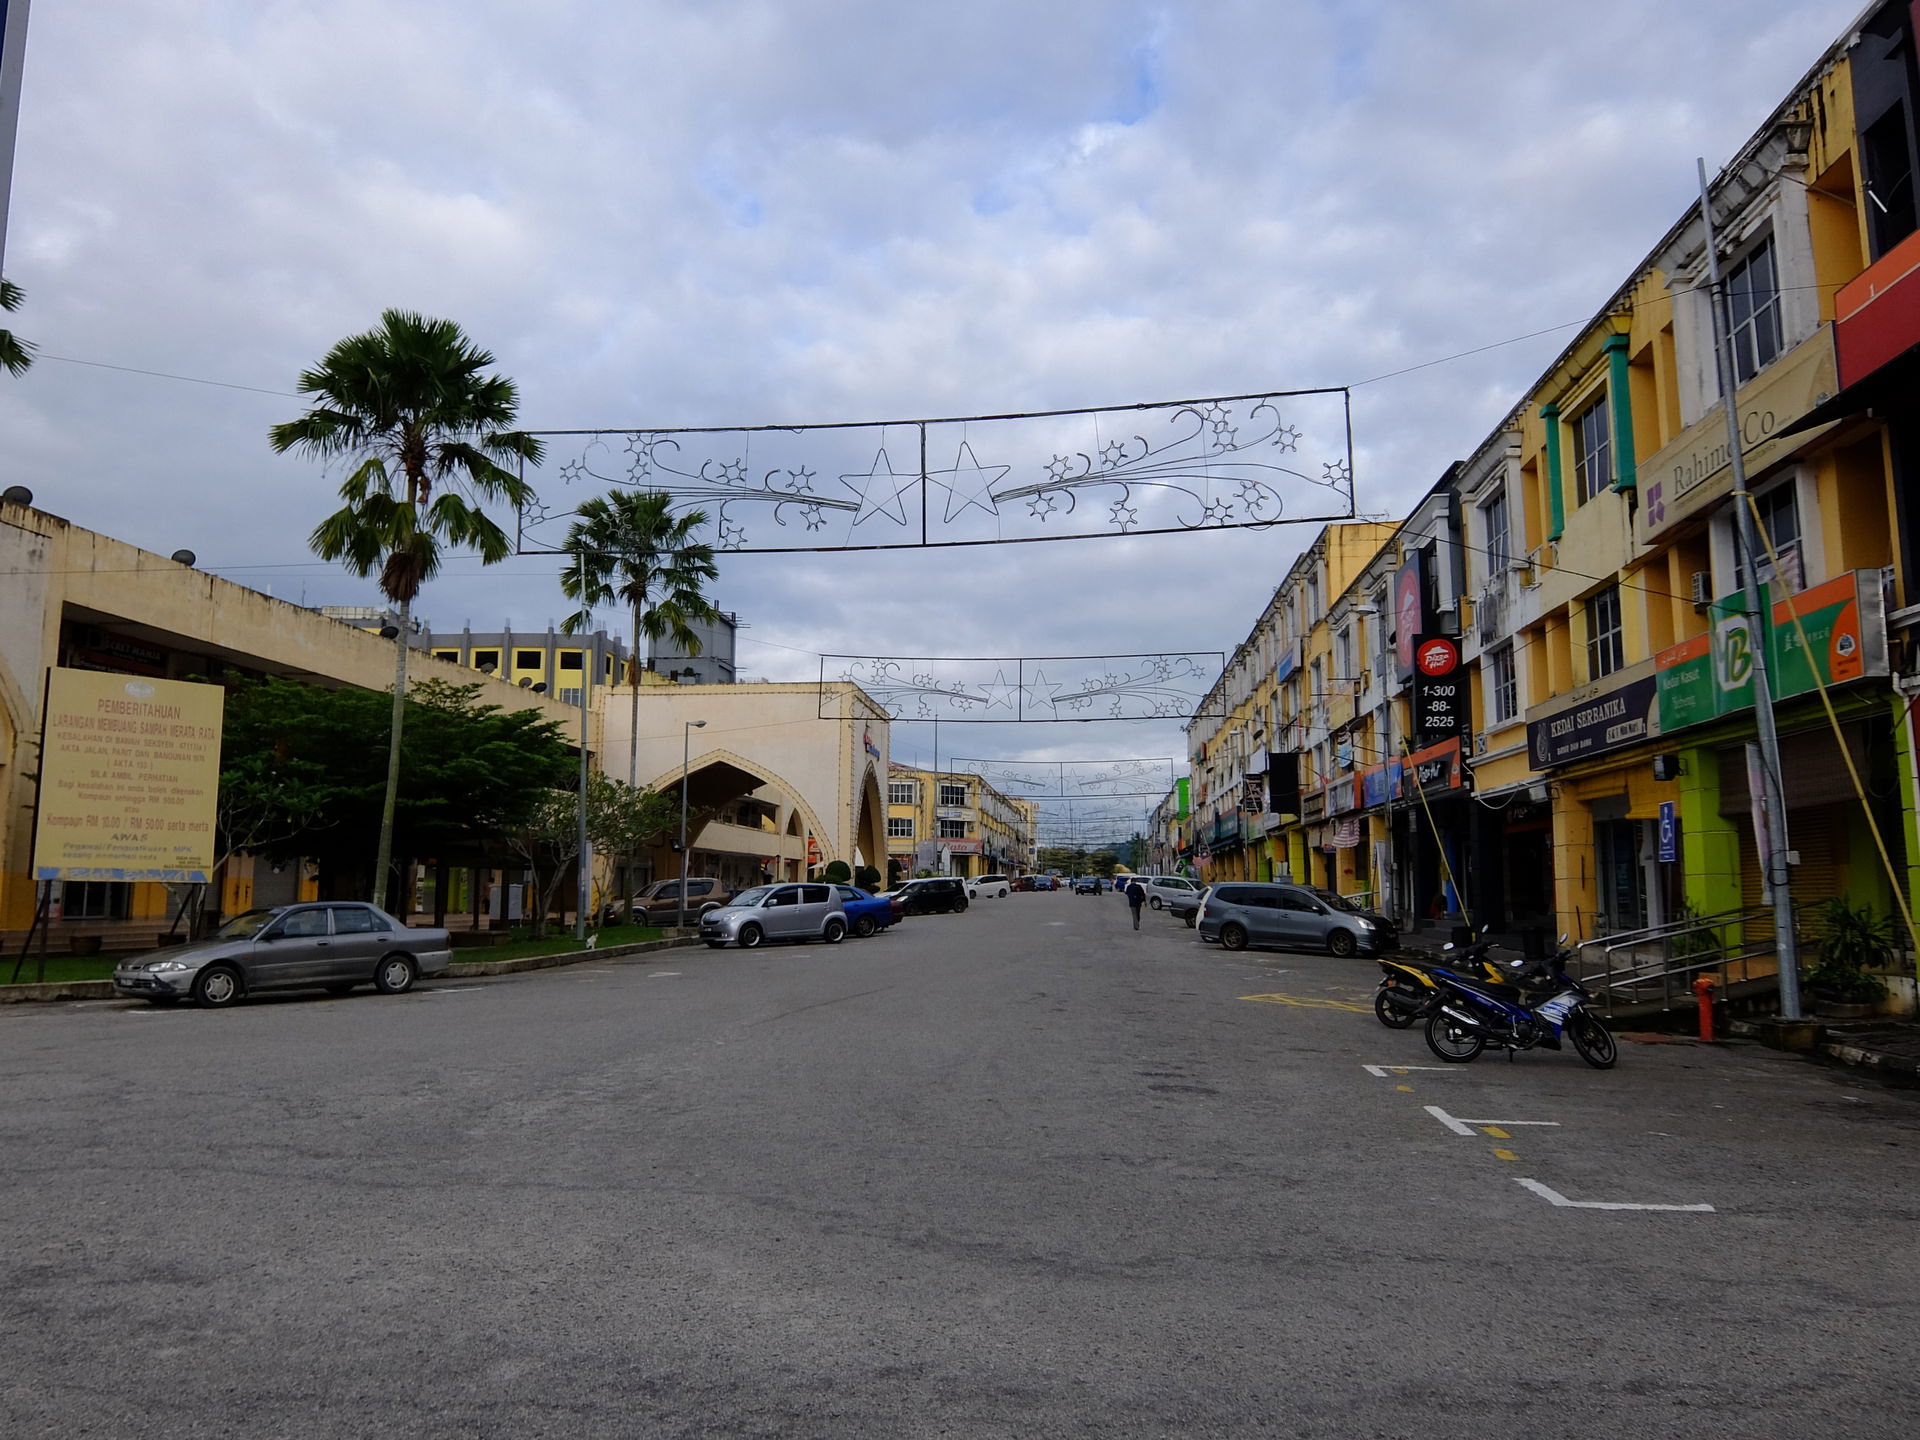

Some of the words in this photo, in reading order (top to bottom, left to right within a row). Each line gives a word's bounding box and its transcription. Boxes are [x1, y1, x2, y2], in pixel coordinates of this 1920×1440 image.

[1673, 446, 1728, 495] Rahim
[1425, 654, 1449, 666] Pizza
[1429, 660, 1448, 669] Hut
[1422, 685, 1456, 697] 1-300
[98, 698, 181, 720] PEMBERITAHUAN
[1426, 701, 1451, 712] -88-
[1425, 716, 1455, 727] 2525
[1550, 715, 1576, 738] KEDAI
[1576, 697, 1627, 729] SERBANIKA
[52, 713, 95, 729] LARANGAN
[97, 717, 137, 734] MEMBUANG
[140, 721, 168, 737] SAMPAH
[169, 724, 195, 738] MERATA
[199, 726, 215, 739] RATA
[47, 813, 82, 828] Kompaun
[86, 814, 98, 827] RM
[130, 816, 142, 829] RM
[167, 820, 185, 832] serta
[188, 820, 209, 832] merta
[110, 832, 148, 842] AWAS
